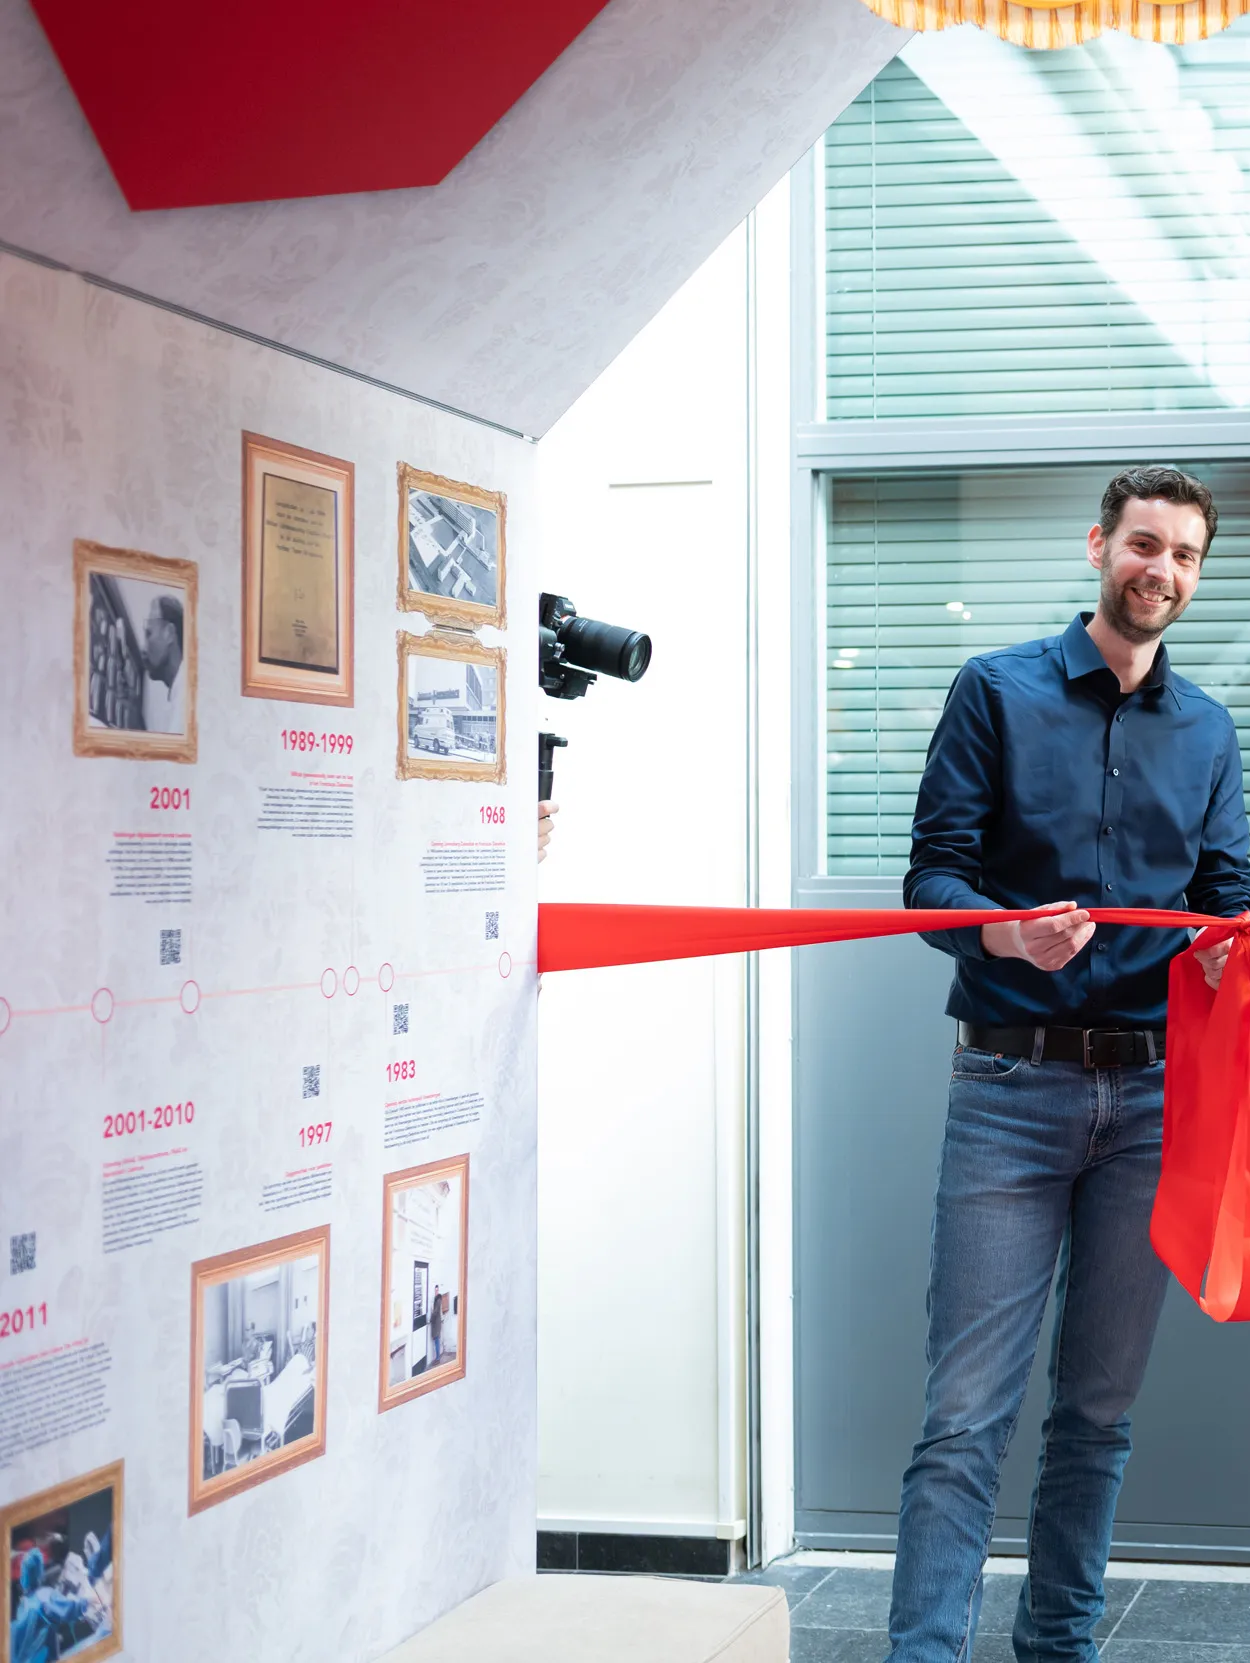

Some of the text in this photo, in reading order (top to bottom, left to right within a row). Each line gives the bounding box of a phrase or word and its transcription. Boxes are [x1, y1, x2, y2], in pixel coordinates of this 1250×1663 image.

[281, 729, 353, 755] 1989-1999
[150, 786, 191, 810] 2001
[480, 805, 505, 824] 1968
[386, 1059, 416, 1082] 1983
[103, 1100, 195, 1139] 2001-2010
[299, 1121, 333, 1147] 1997
[0, 1302, 47, 1339] 2011
